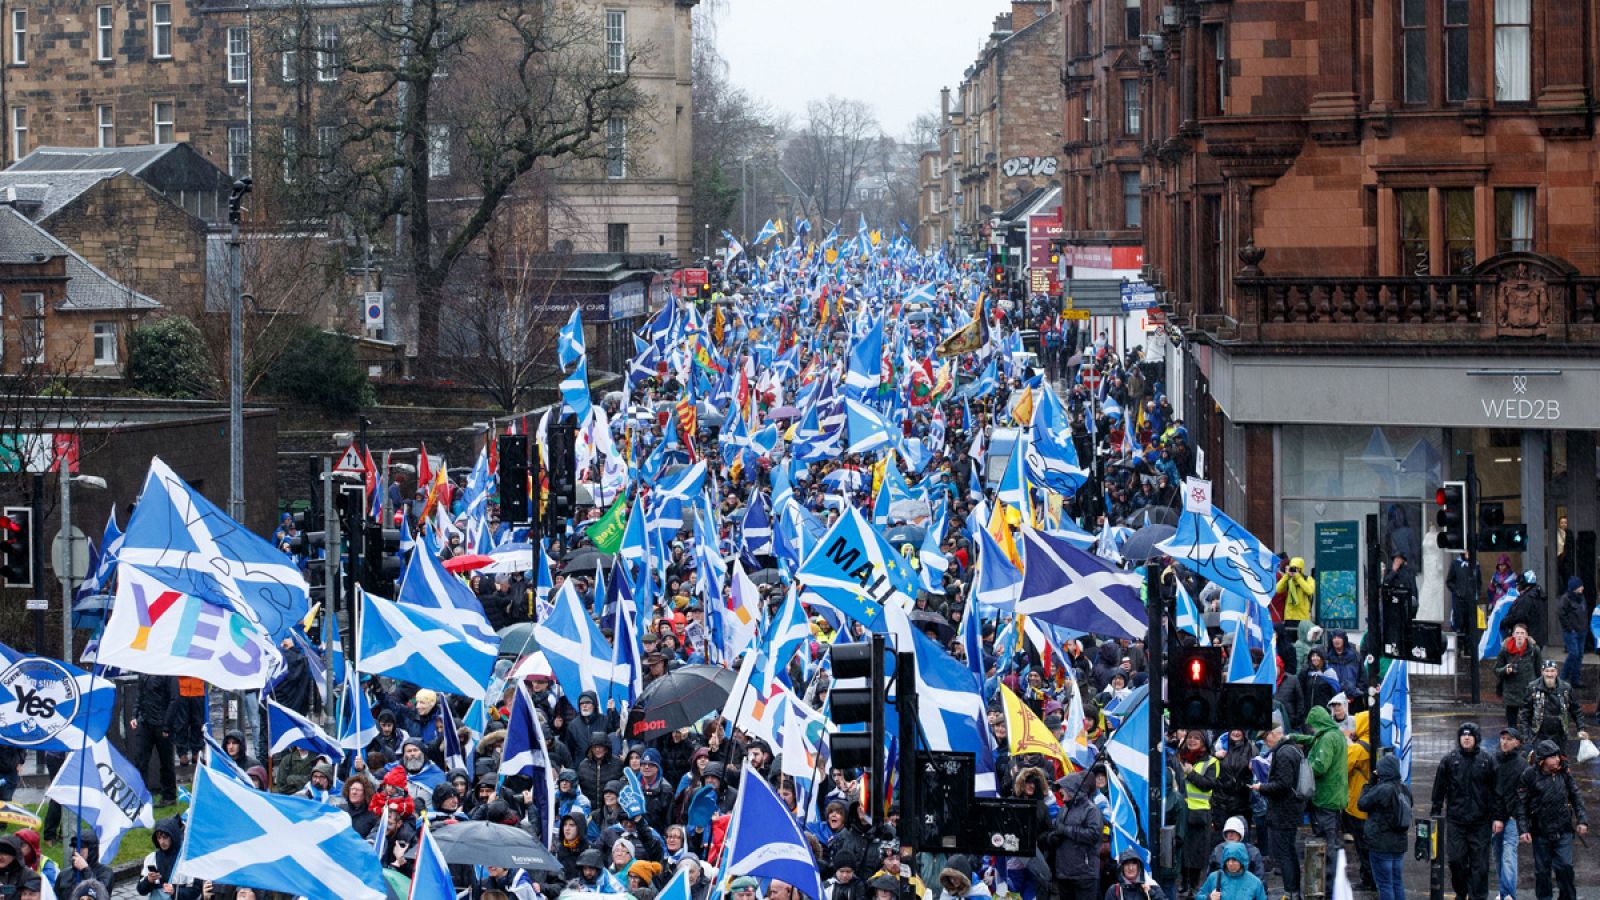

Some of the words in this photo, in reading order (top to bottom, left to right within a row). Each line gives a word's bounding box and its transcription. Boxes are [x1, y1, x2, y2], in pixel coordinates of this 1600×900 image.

[1481, 399, 1561, 420] WED2B
[130, 581, 262, 677] YES
[14, 684, 57, 719] Yes
